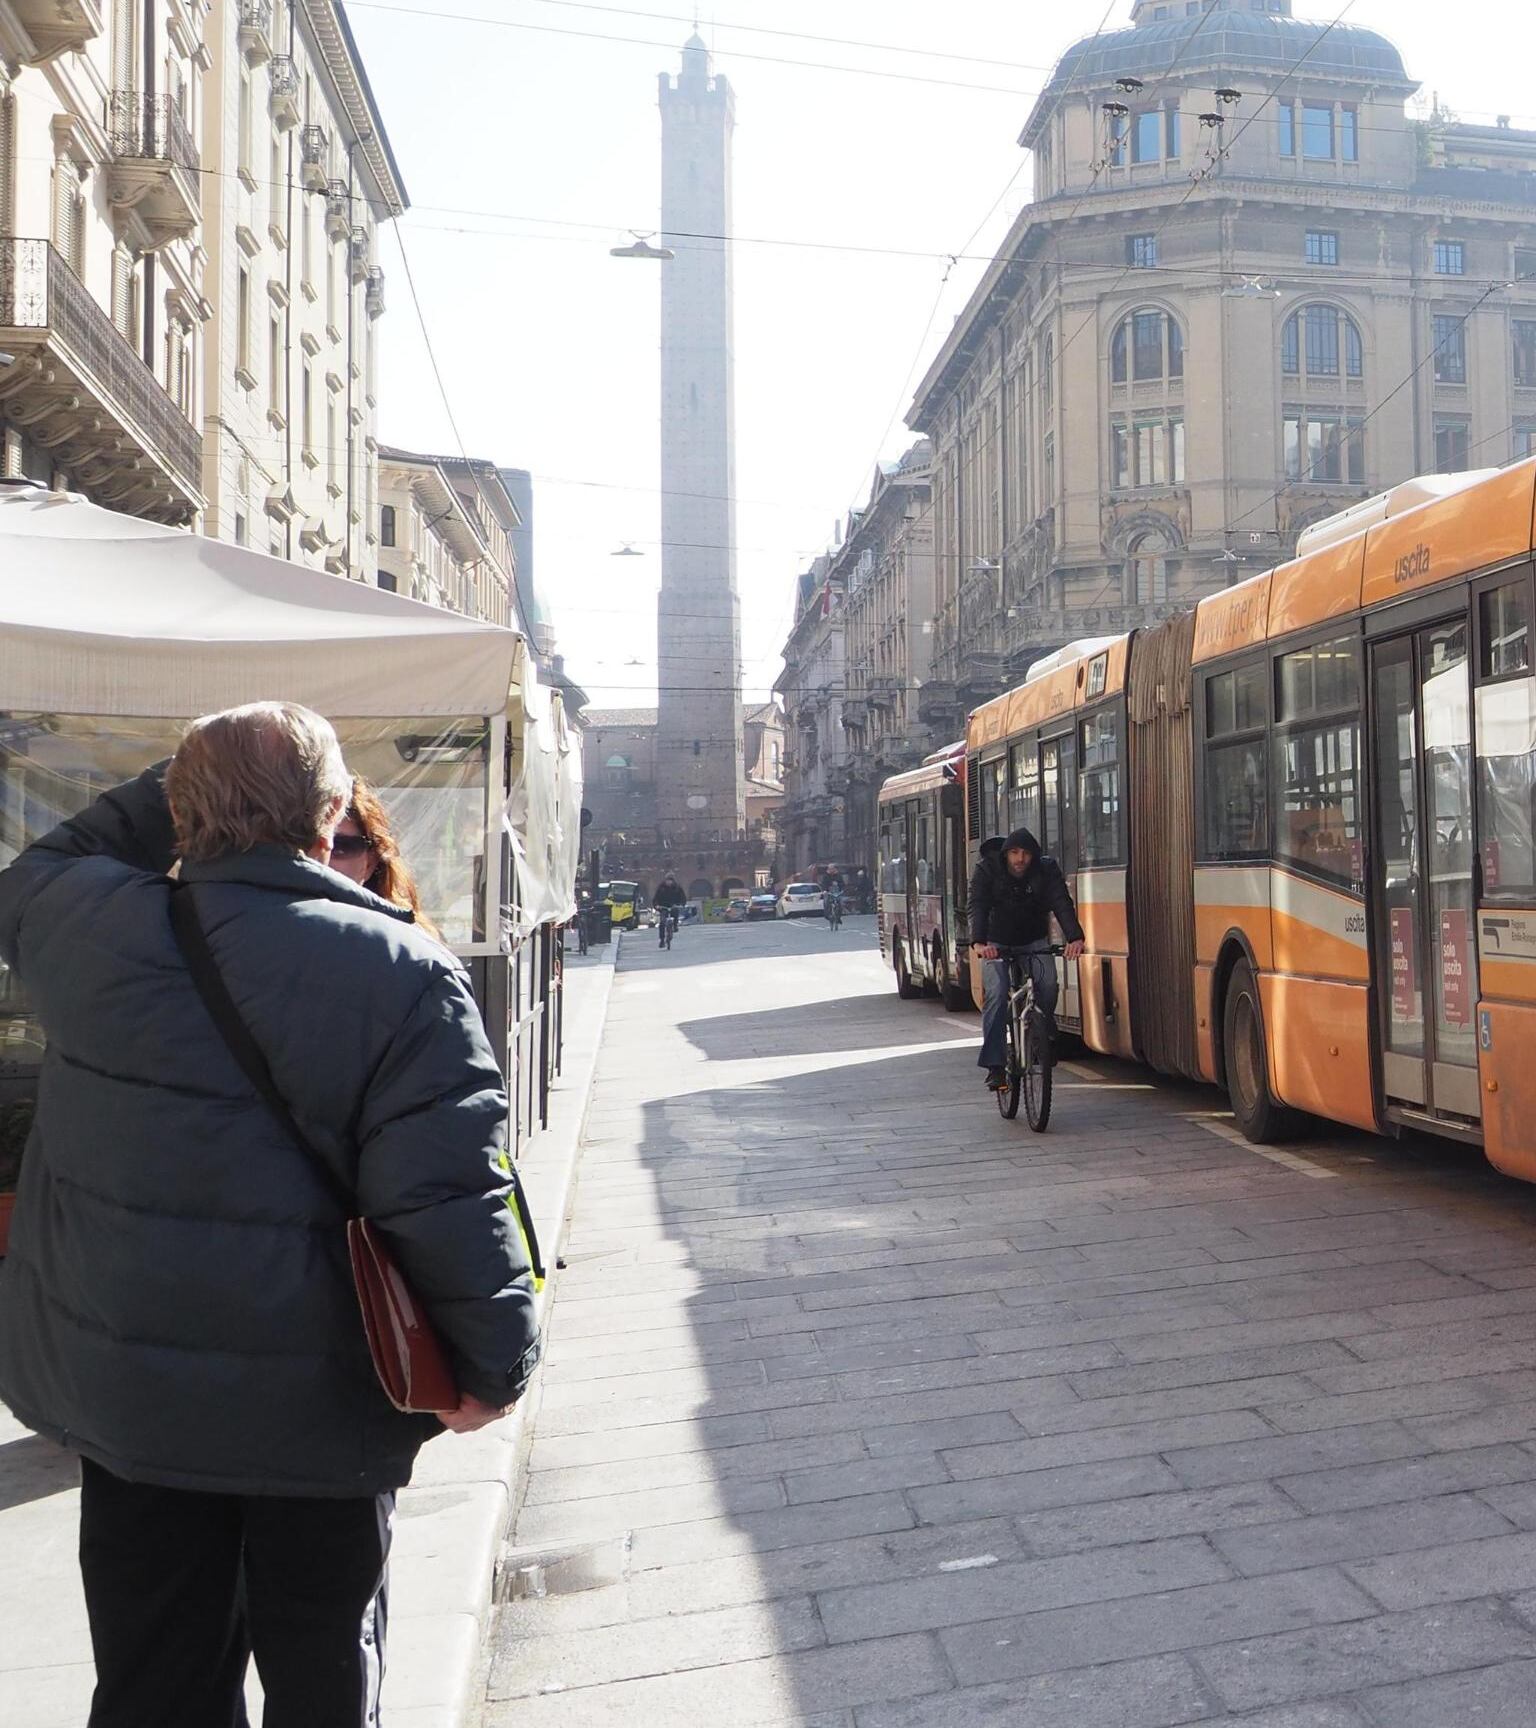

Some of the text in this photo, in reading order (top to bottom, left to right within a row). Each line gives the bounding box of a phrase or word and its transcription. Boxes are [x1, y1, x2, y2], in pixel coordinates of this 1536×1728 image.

[1394, 543, 1430, 584] uscita
[1344, 913, 1365, 933] uscita
[1443, 941, 1456, 957] solo
[1444, 959, 1462, 976] uscita
